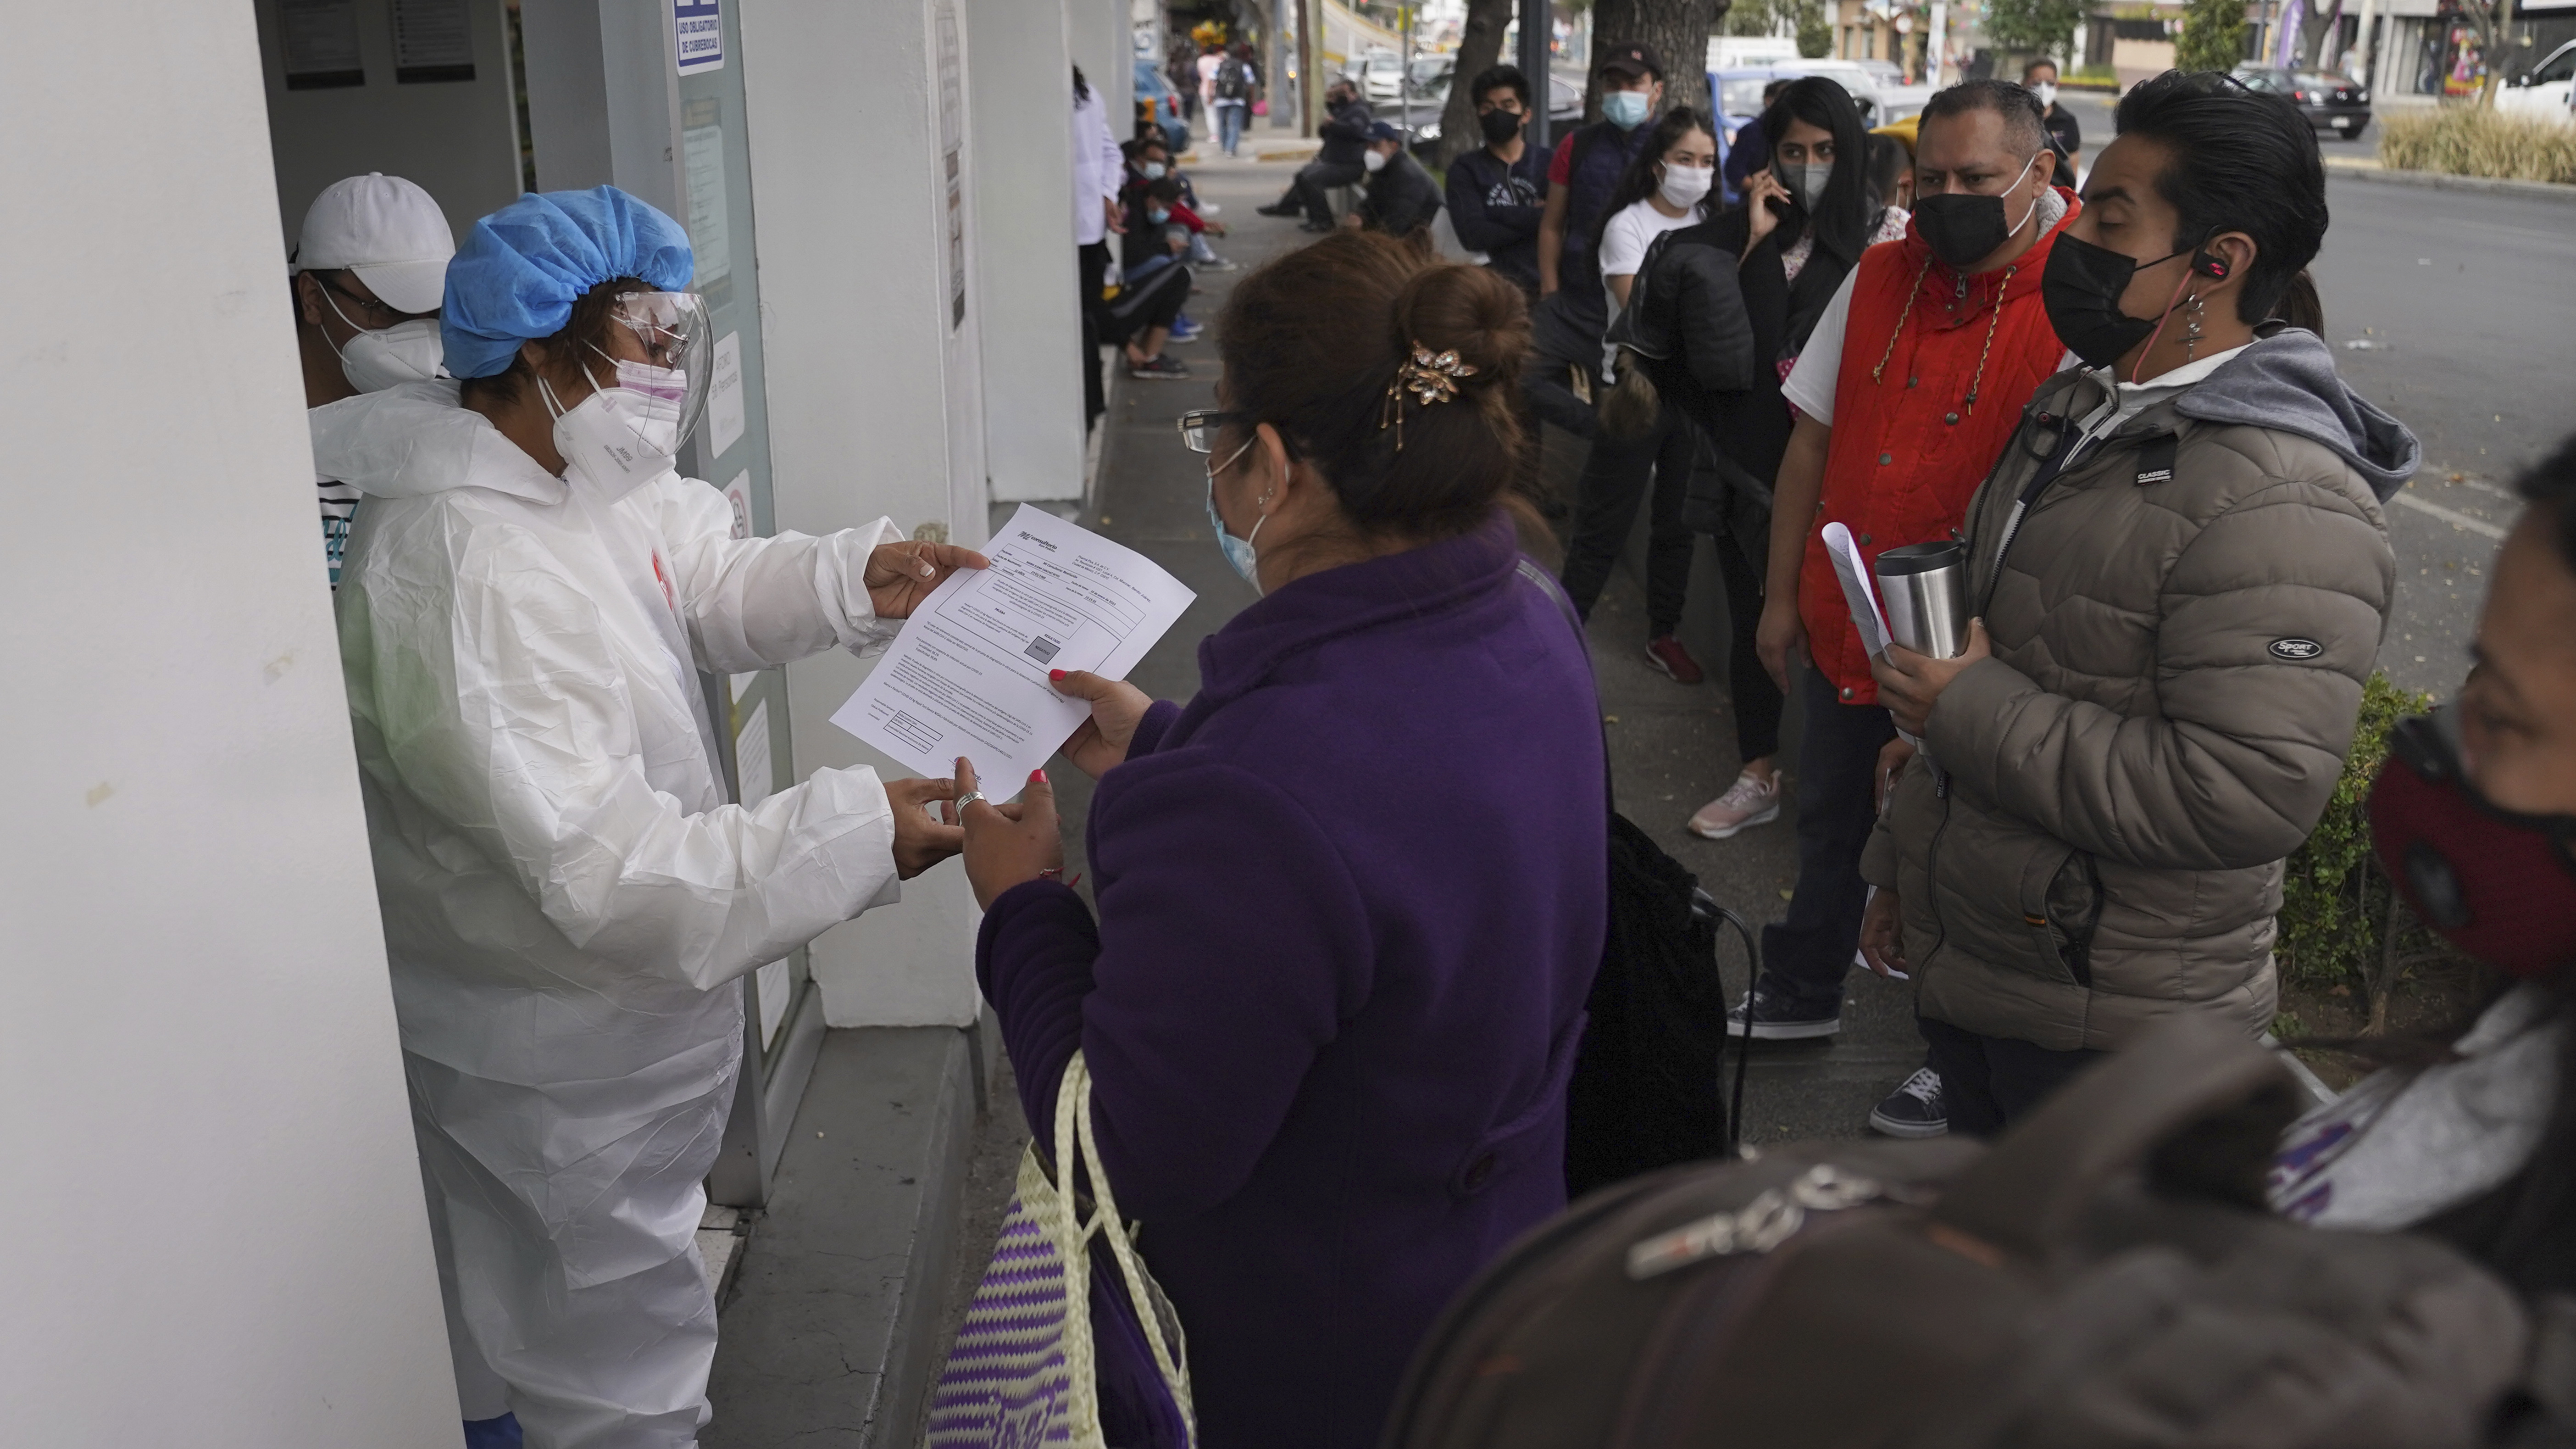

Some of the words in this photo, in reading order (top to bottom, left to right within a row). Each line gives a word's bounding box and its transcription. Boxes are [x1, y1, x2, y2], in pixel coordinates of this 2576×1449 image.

[679, 22, 688, 34] USO
[689, 19, 717, 33] OBLIGATORIO
[682, 41, 688, 53] DE
[689, 37, 717, 52] CUBREBOCAS
[616, 447, 633, 462] JM99
[2137, 469, 2170, 479] CLASSIC
[1031, 536, 1057, 550] consultorio
